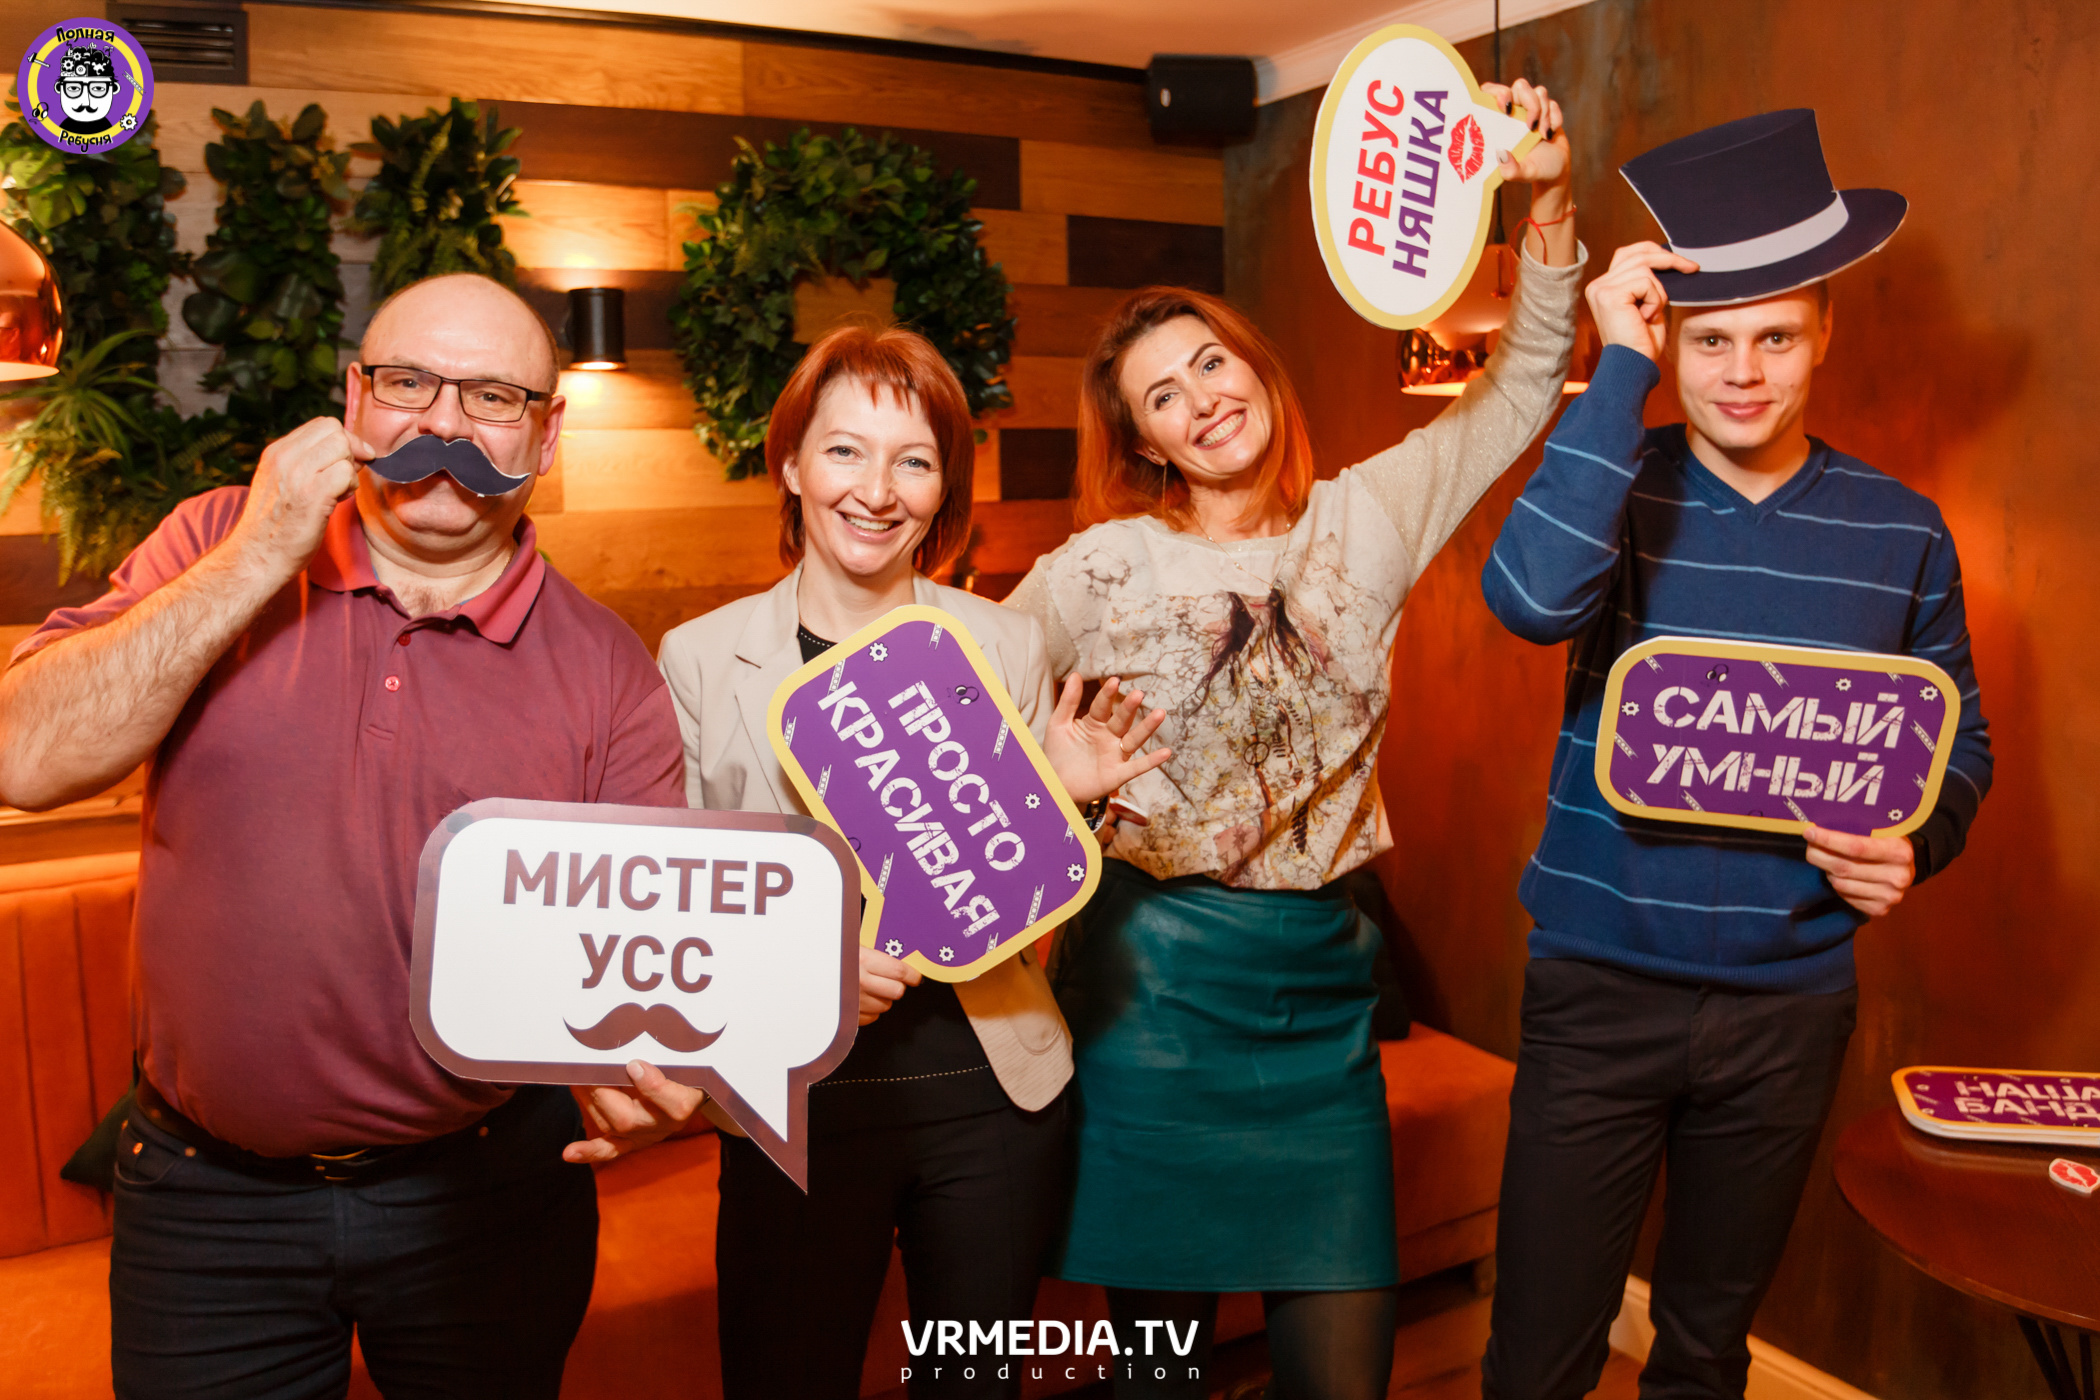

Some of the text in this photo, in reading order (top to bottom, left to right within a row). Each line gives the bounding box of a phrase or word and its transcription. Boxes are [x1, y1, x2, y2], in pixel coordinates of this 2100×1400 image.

[1347, 79, 1405, 256] РЕБУС
[1392, 90, 1449, 279] НЯШКА
[887, 680, 1026, 872] ПРОСТО
[1646, 743, 1885, 806] УМНЫЙ
[1653, 686, 1905, 749] САМЫЙ
[817, 680, 1001, 938] КРАСИВАЯ
[503, 849, 794, 916] МИСТЕР
[578, 932, 714, 994] УСС
